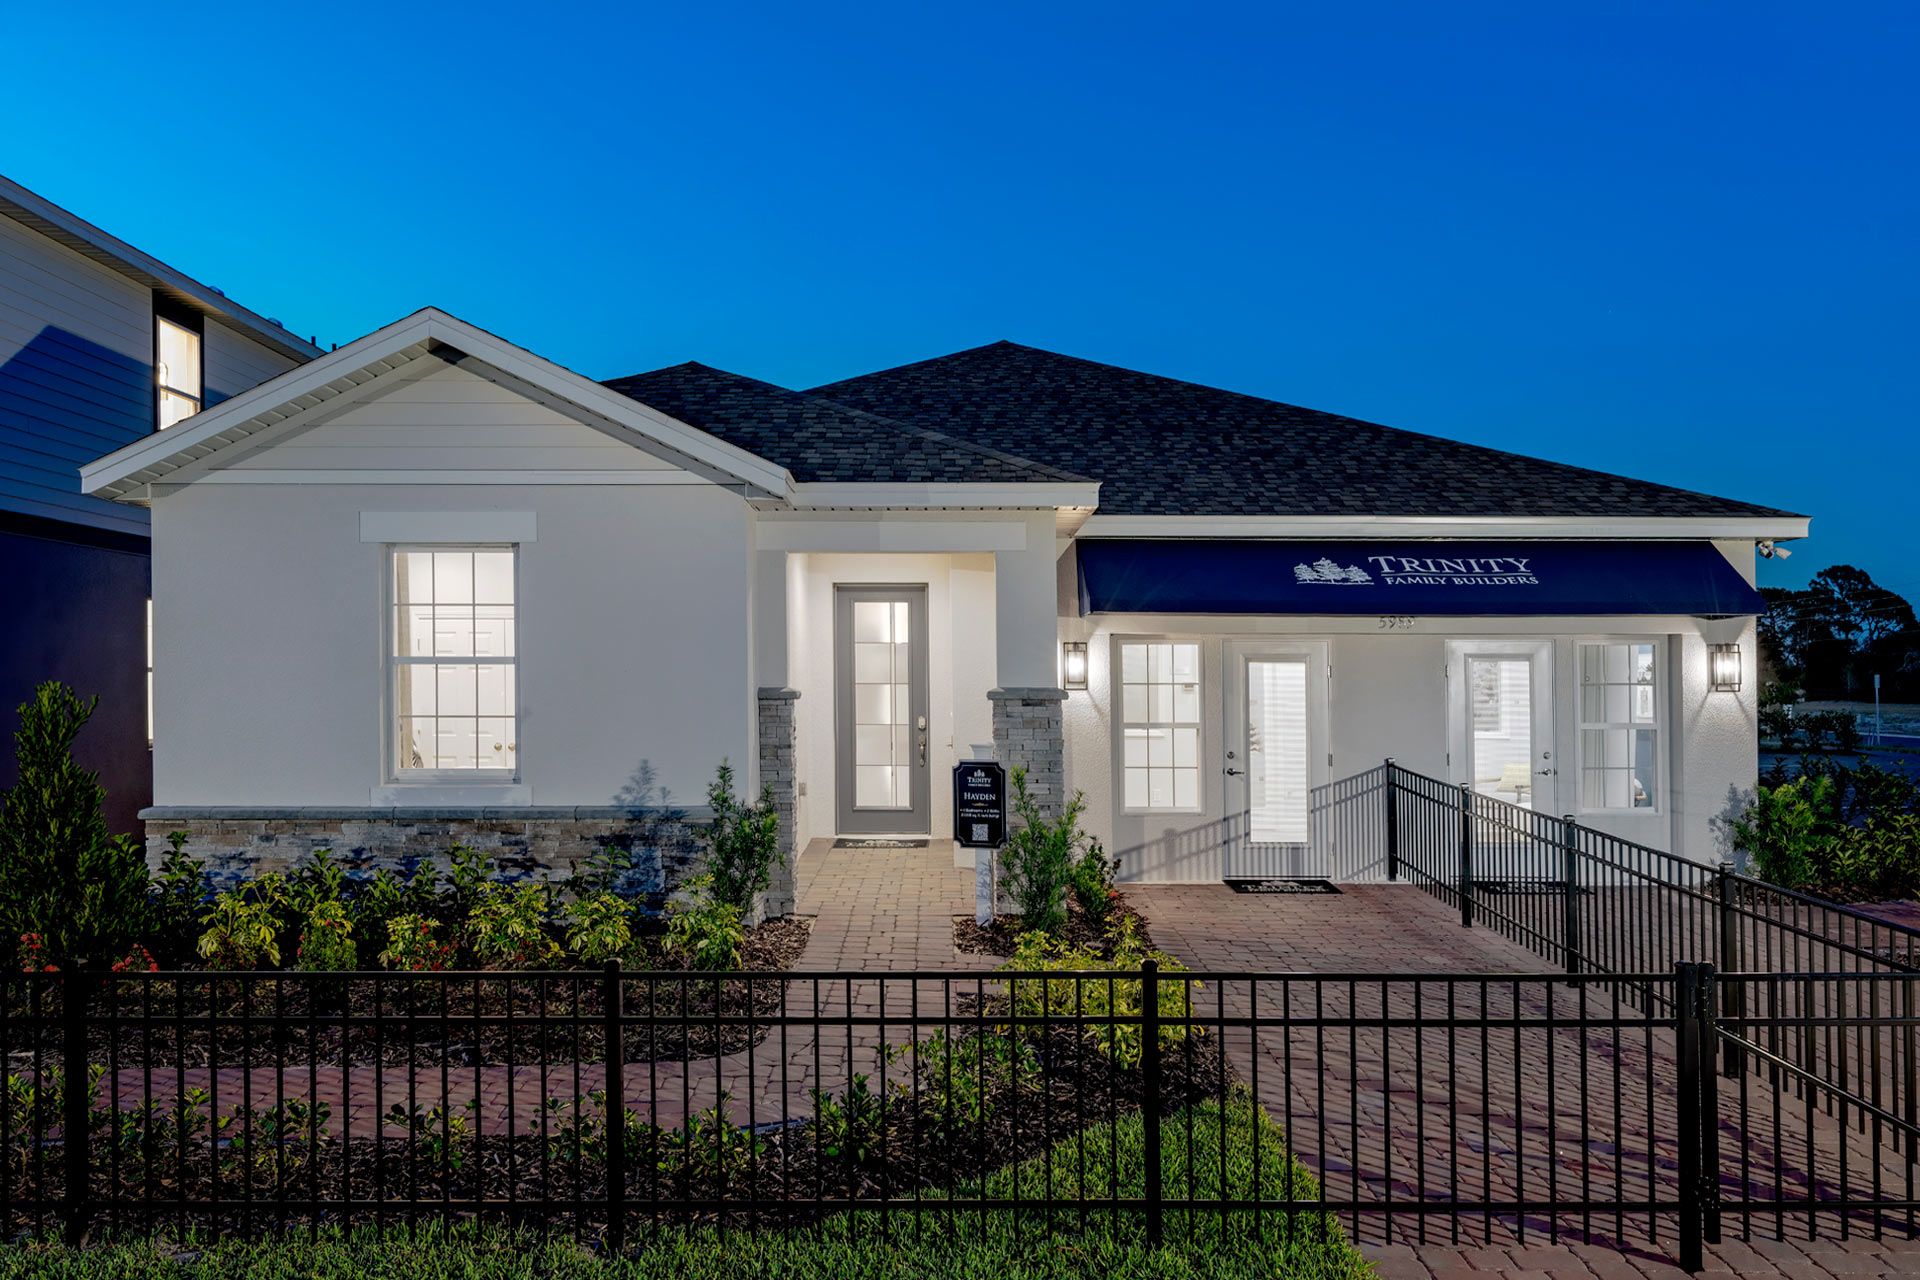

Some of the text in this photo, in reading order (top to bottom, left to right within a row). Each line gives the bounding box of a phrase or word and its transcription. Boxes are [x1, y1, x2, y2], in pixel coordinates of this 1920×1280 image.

[1368, 556, 1531, 573] TRINITY
[1385, 576, 1539, 585] FAMILY BUILDERS
[967, 776, 992, 784] TRINITY
[964, 792, 996, 801] HAYDEN
